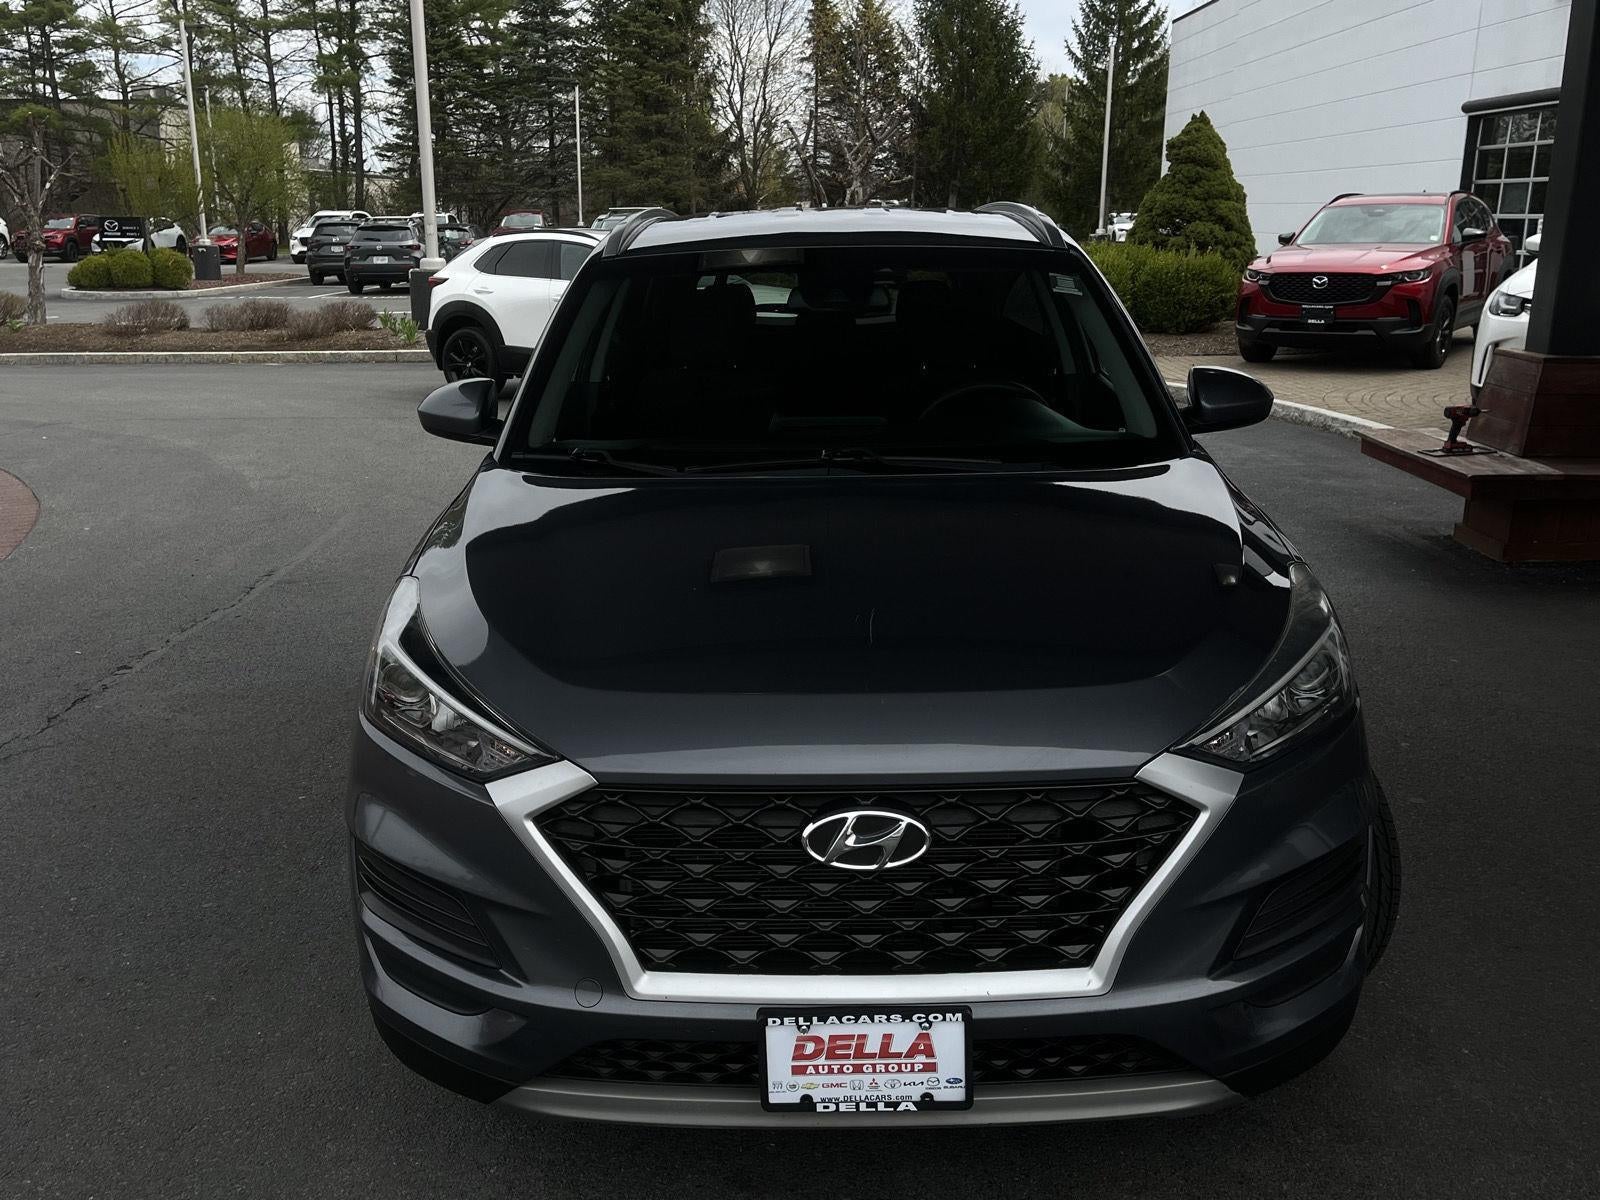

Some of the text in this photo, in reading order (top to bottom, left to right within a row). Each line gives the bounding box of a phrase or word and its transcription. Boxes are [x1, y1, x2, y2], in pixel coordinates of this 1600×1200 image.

[767, 1013, 963, 1026] DELLACARS.COM
[791, 1032, 938, 1062] DELLA
[806, 1063, 924, 1074] AUTO GROUP
[820, 1094, 913, 1102] www.DELLACARS.com
[816, 1101, 918, 1112] DELLA
